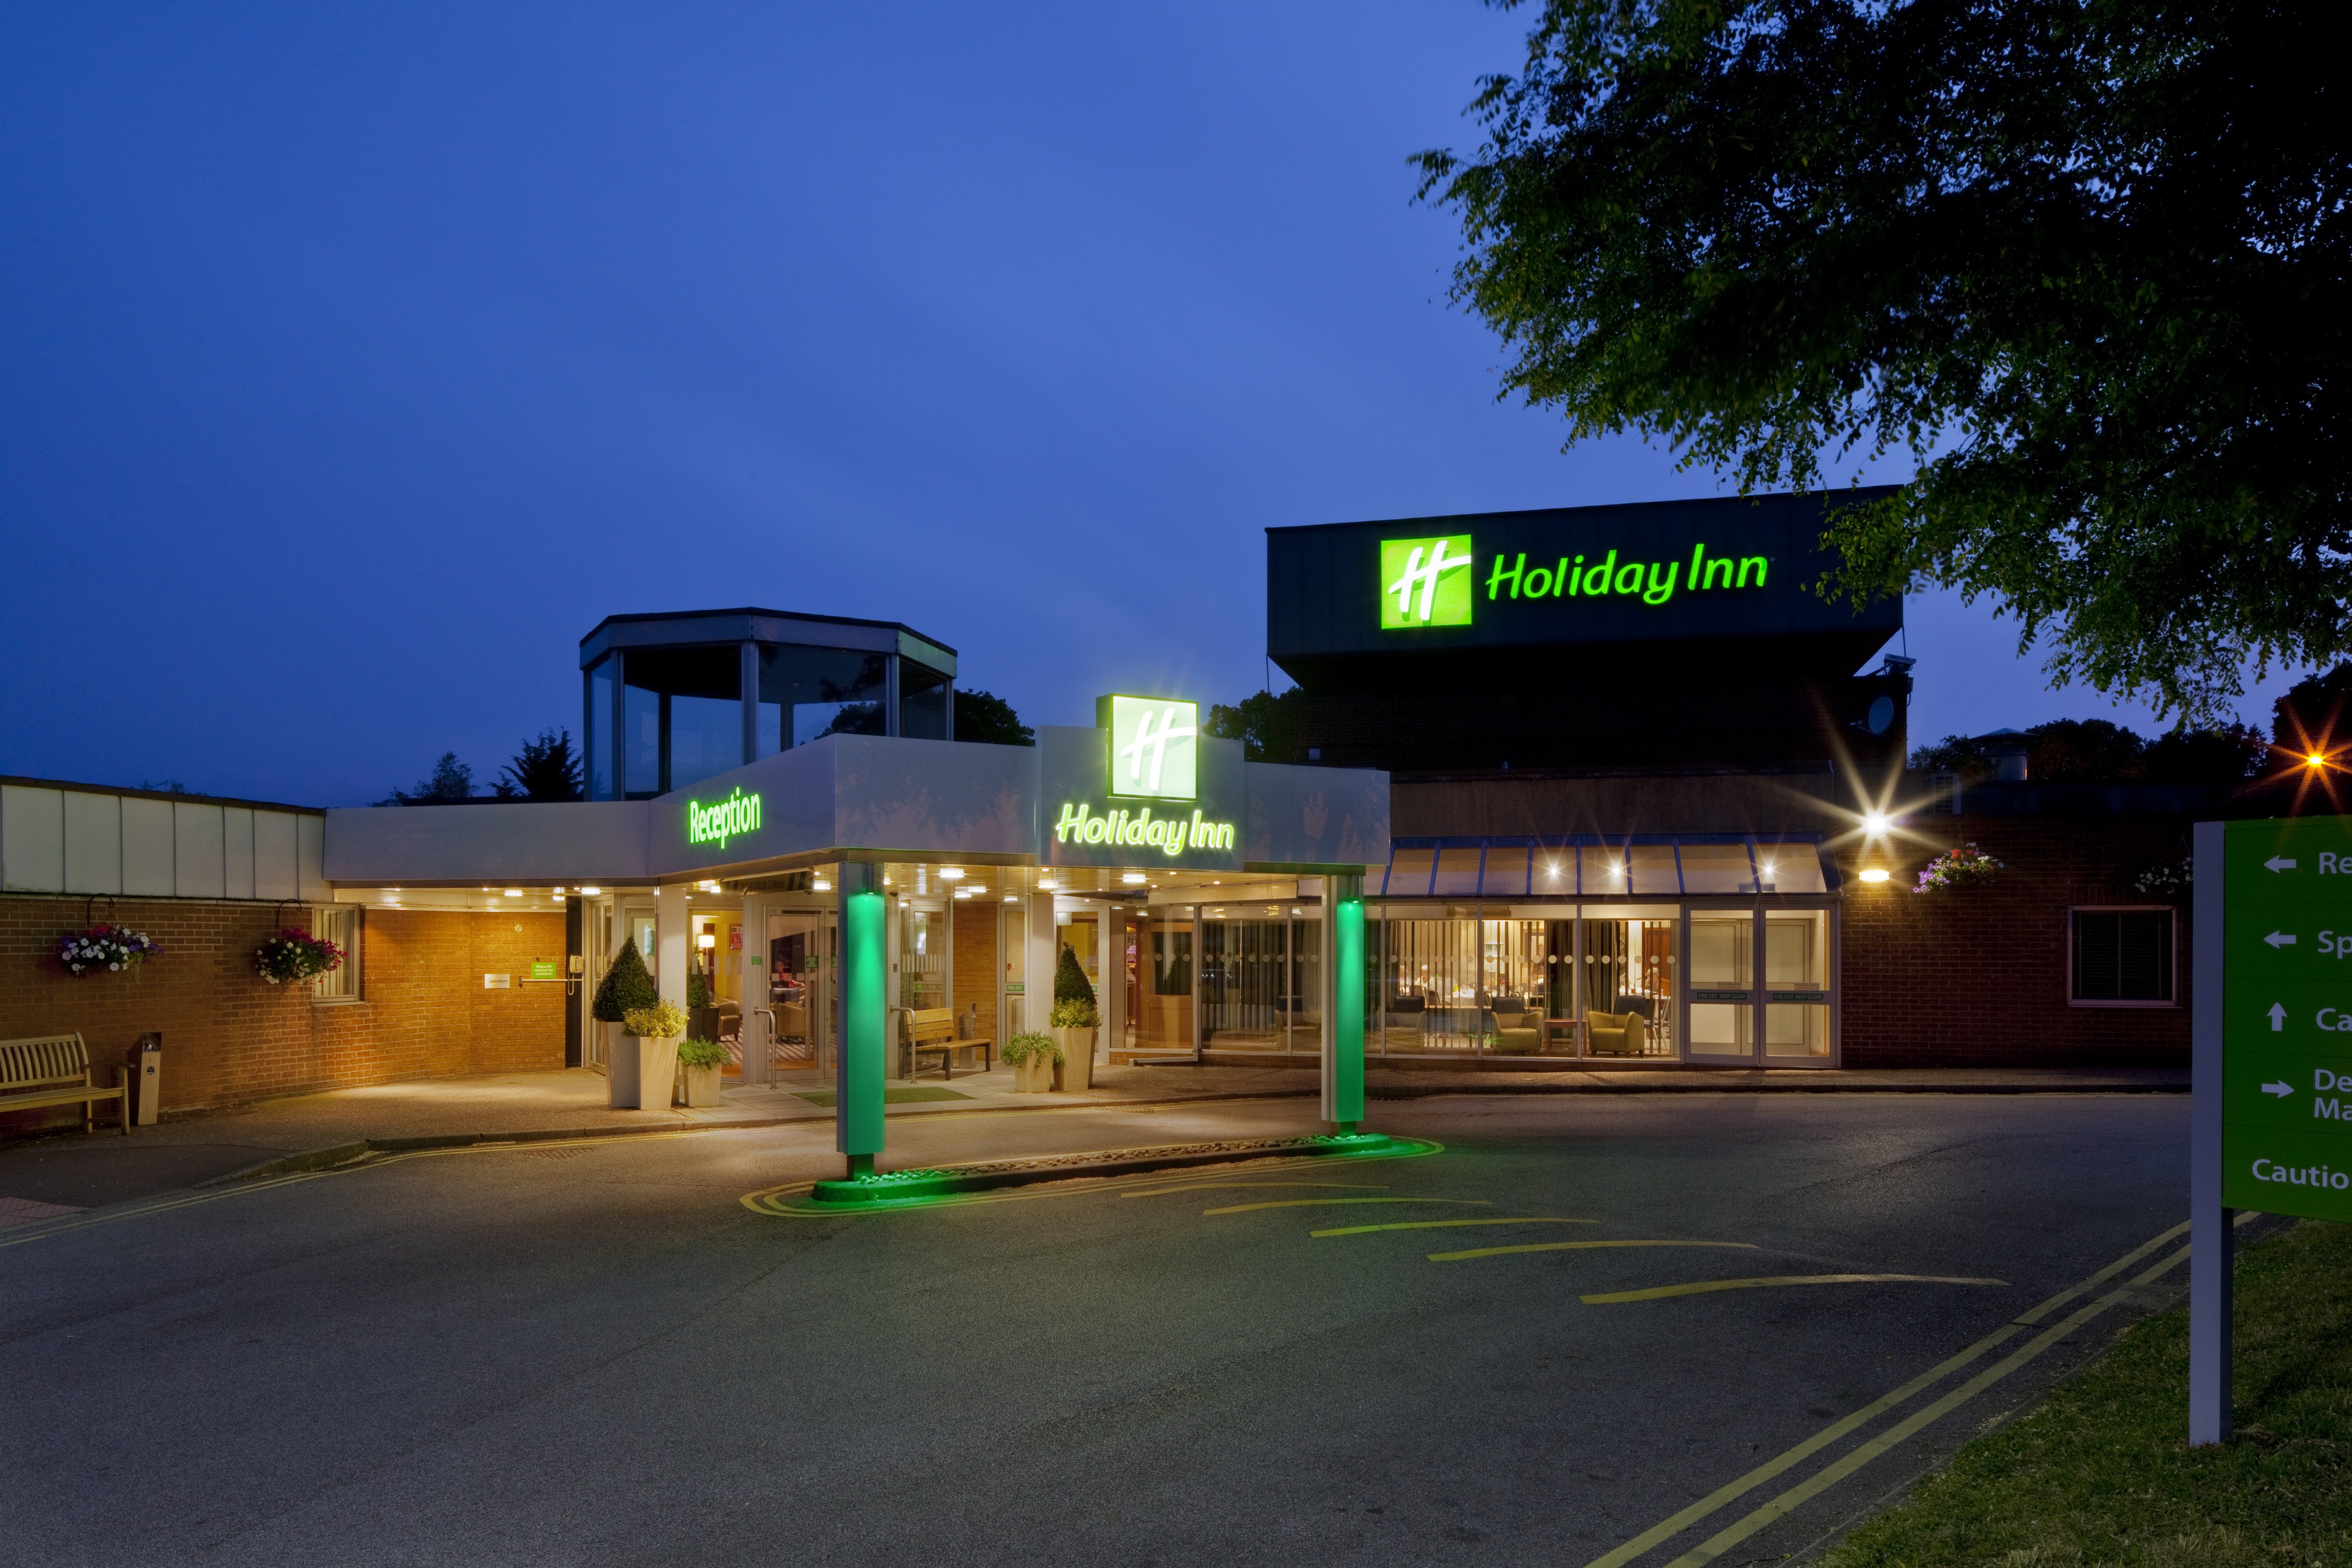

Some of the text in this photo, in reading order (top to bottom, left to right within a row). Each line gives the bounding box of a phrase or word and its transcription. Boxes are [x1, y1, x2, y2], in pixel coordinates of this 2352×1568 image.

[1485, 544, 1767, 604] Holiday Inn
[690, 787, 760, 849] Reception
[1055, 803, 1235, 855] Holiday Inn
[2319, 852, 2352, 874] Re
[2318, 931, 2352, 959] Sp
[2316, 1008, 2352, 1031] Ca
[2315, 1069, 2352, 1092] De
[2314, 1097, 2352, 1121] Ma
[2252, 1159, 2349, 1189] Cautio
